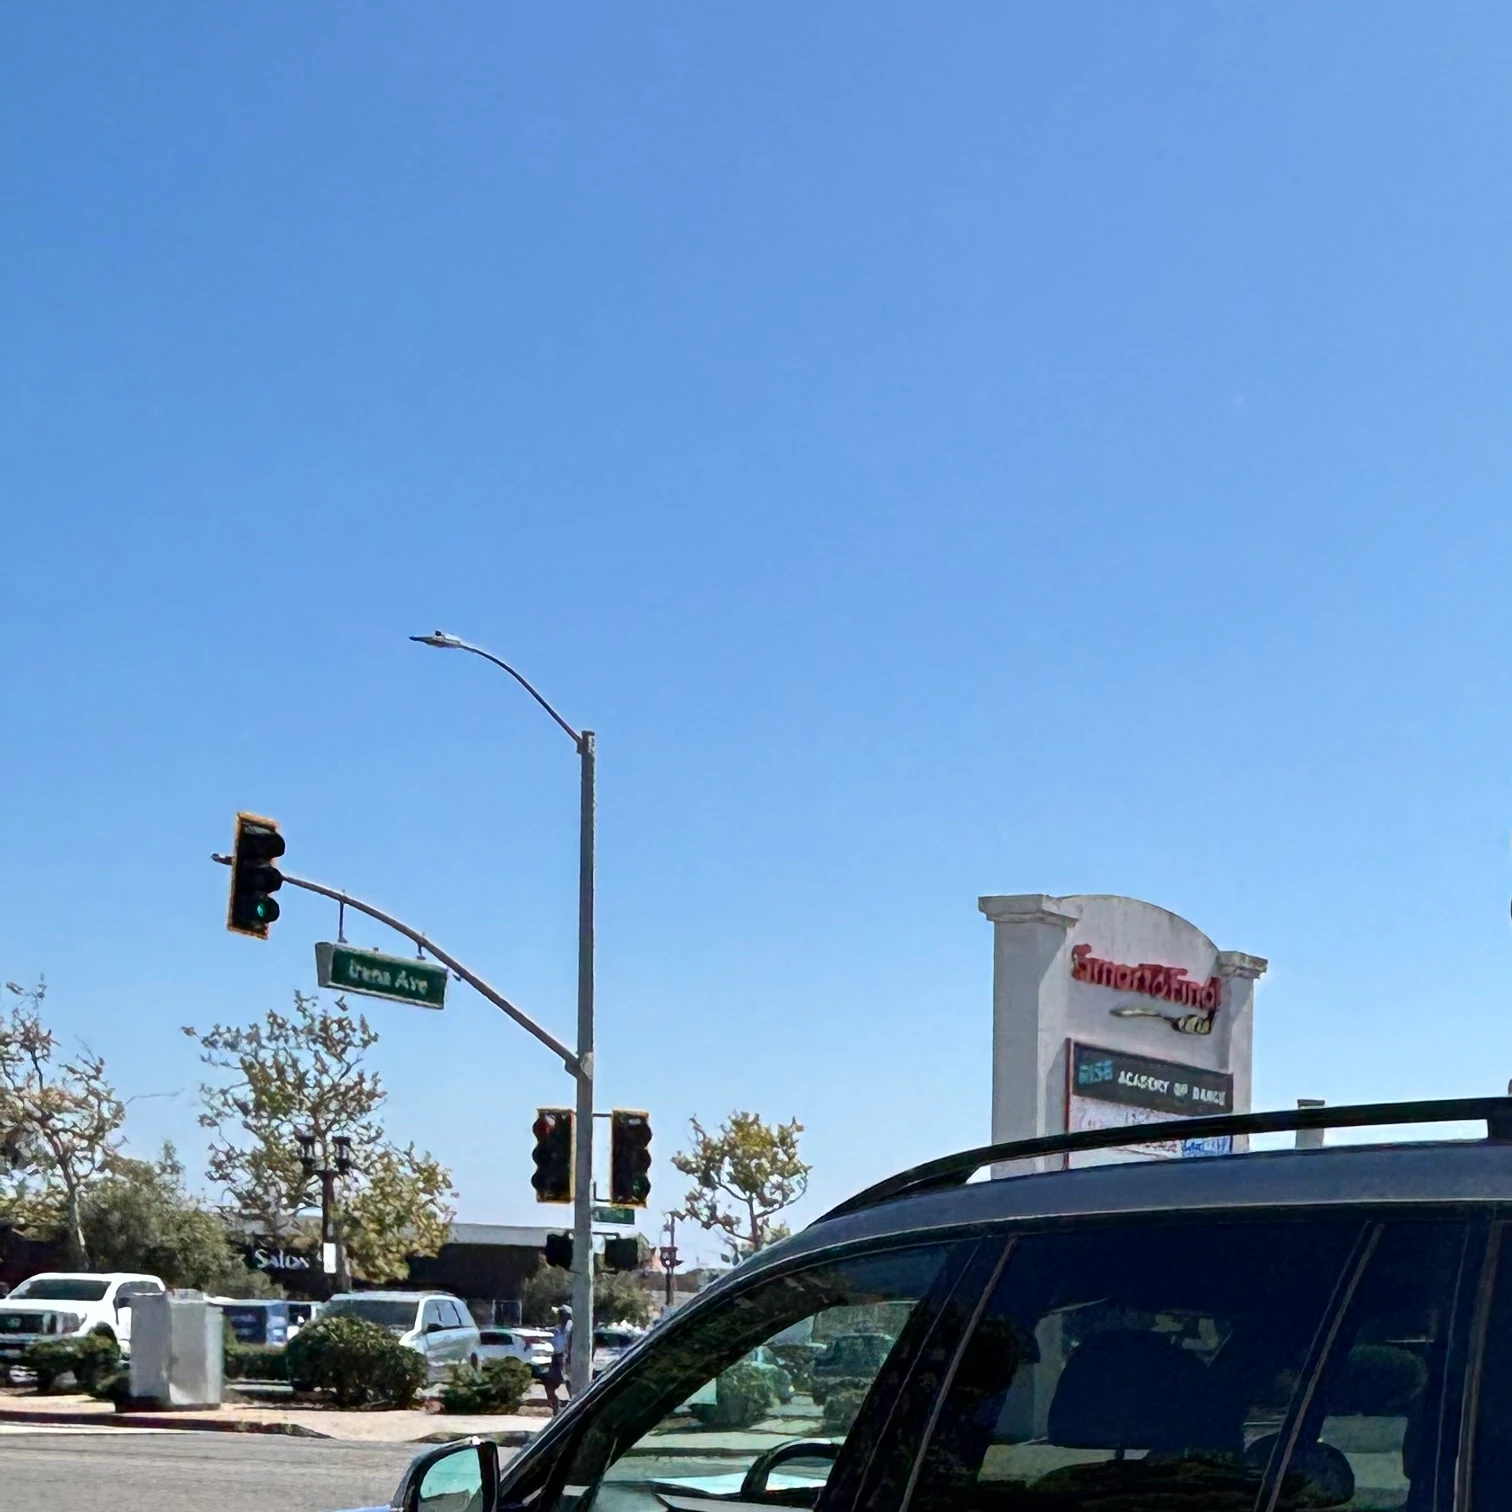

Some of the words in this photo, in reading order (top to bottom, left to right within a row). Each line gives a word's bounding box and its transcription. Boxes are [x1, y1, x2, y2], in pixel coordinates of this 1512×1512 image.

[394, 969, 429, 996] Ave
[1117, 1070, 1170, 1094] ACADEMY
[1192, 1086, 1226, 1106] DANCE
